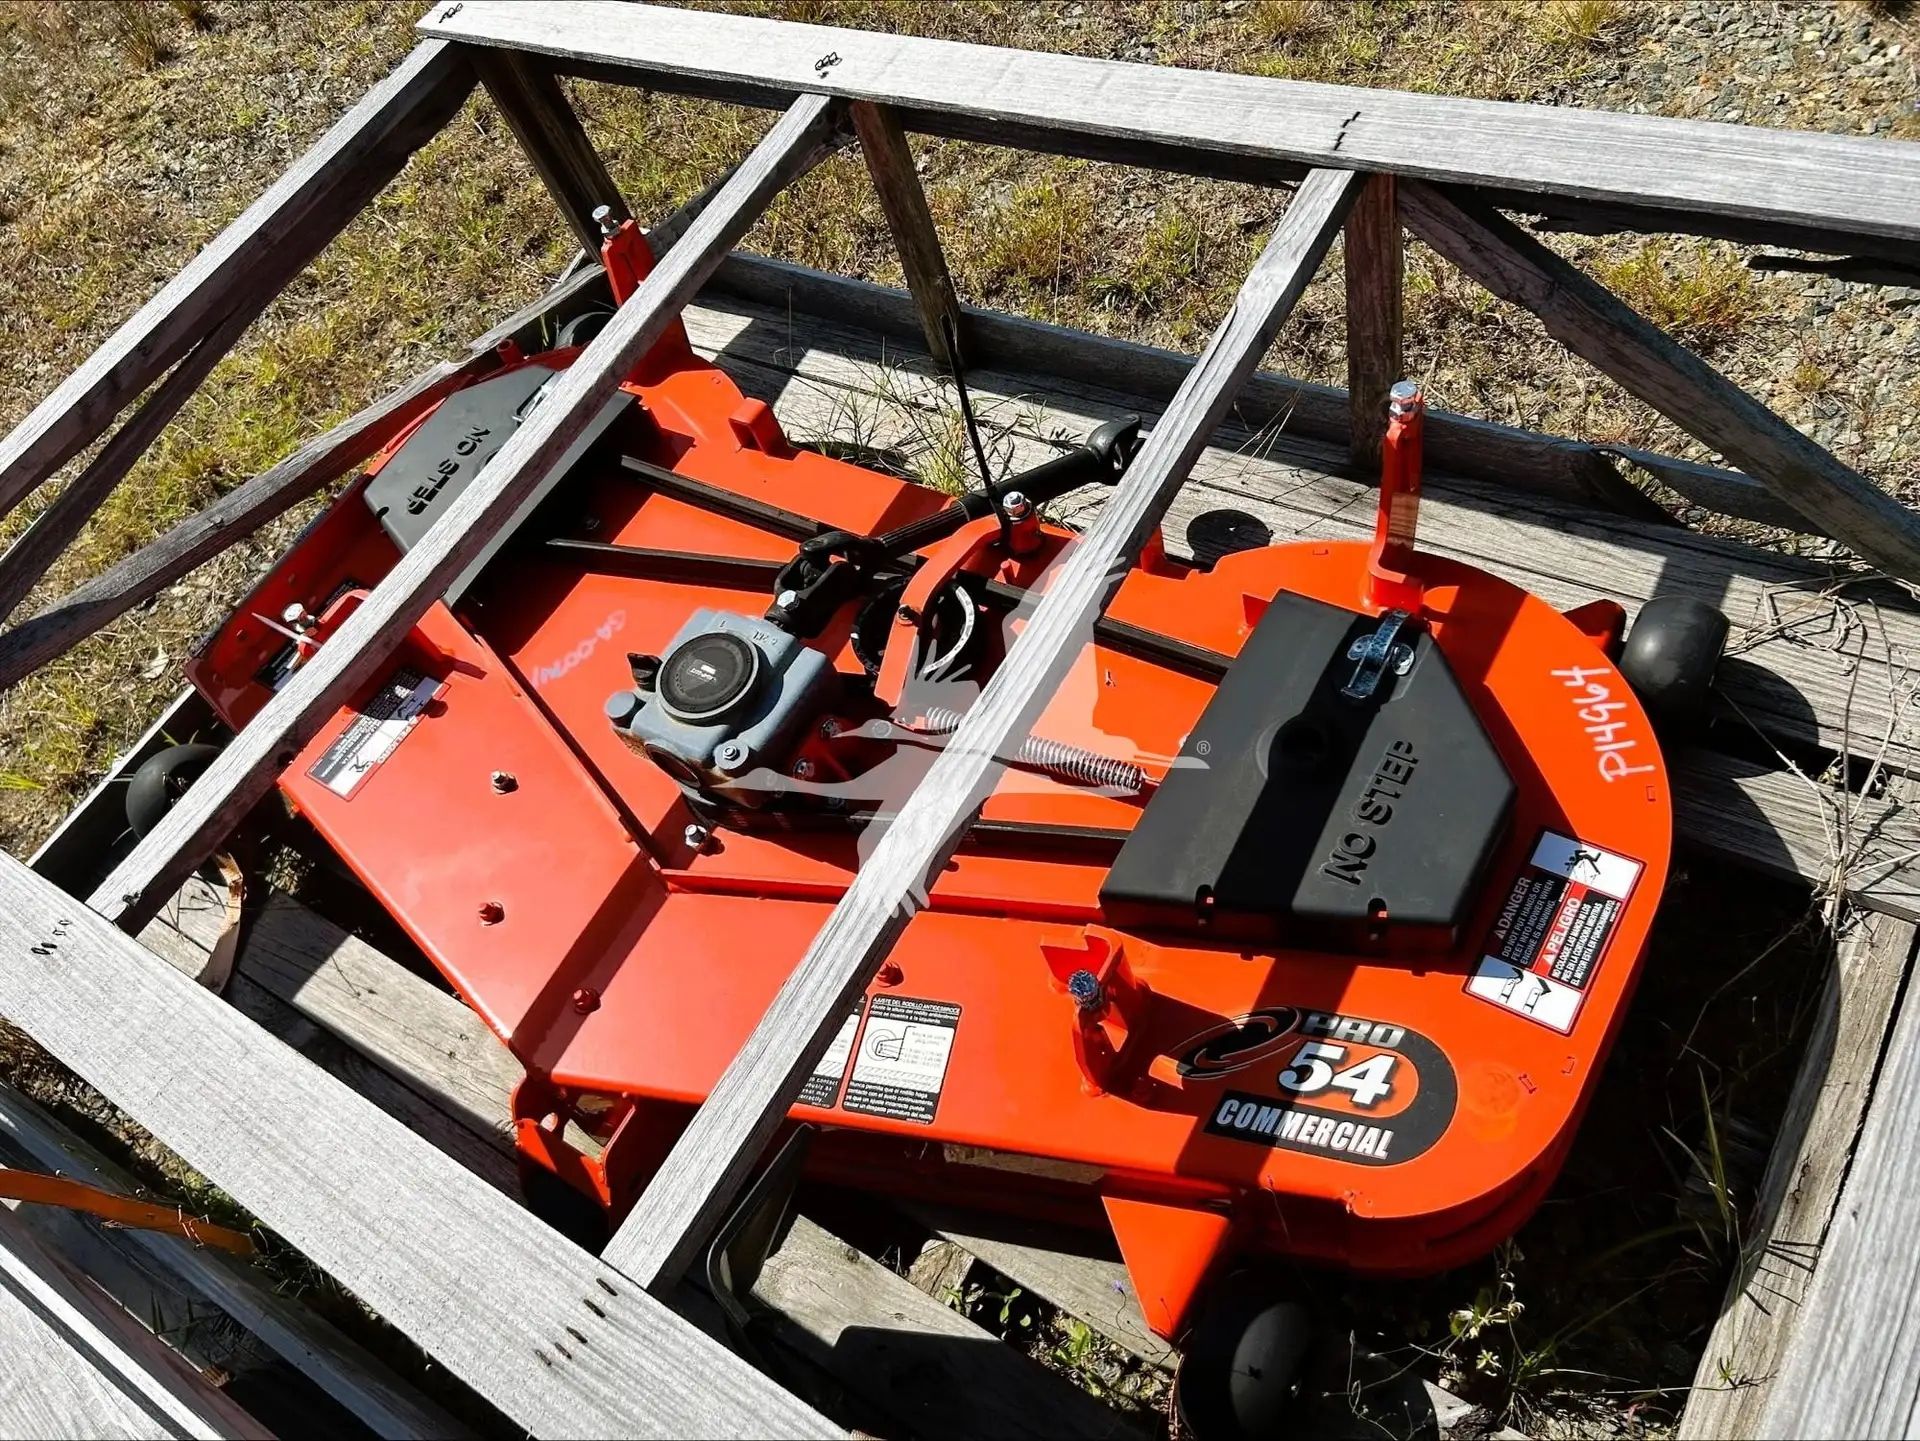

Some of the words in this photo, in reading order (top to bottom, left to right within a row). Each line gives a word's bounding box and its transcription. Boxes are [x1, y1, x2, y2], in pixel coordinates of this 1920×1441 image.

[454, 424, 492, 457] NO
[406, 457, 460, 516] STEP
[1319, 831, 1377, 886] NO
[1356, 740, 1420, 826] STEP
[1531, 881, 1542, 893] OR
[1497, 875, 1531, 929] DANGER
[1520, 892, 1537, 916] HANDS
[1580, 903, 1591, 914] LOS
[1510, 942, 1524, 961] FEET
[1519, 925, 1532, 943] INTO
[1526, 899, 1544, 926] MOWER
[1539, 879, 1554, 900] WHEN
[1513, 916, 1525, 930] PUT
[1546, 895, 1580, 953] PELIGRO
[1570, 918, 1584, 937] MANOS
[1506, 929, 1519, 946] NOT
[1520, 937, 1537, 965] ENGINE
[1532, 930, 1541, 938] IS
[1565, 935, 1576, 947] LAS
[1572, 925, 1592, 956] CORTADORA
[1501, 945, 1512, 957] DO
[1555, 945, 1572, 970] COLOQUE
[1569, 954, 1579, 963] LA
[1551, 968, 1561, 978] NO
[1561, 969, 1572, 982] PIES
[1566, 961, 1576, 970] EN
[1574, 959, 1587, 978] MOTOR
[1571, 977, 1579, 985] EL
[1301, 1012, 1405, 1049] PRO
[1277, 1042, 1398, 1107] 54
[1216, 1098, 1396, 1160] COMMERCIAL
